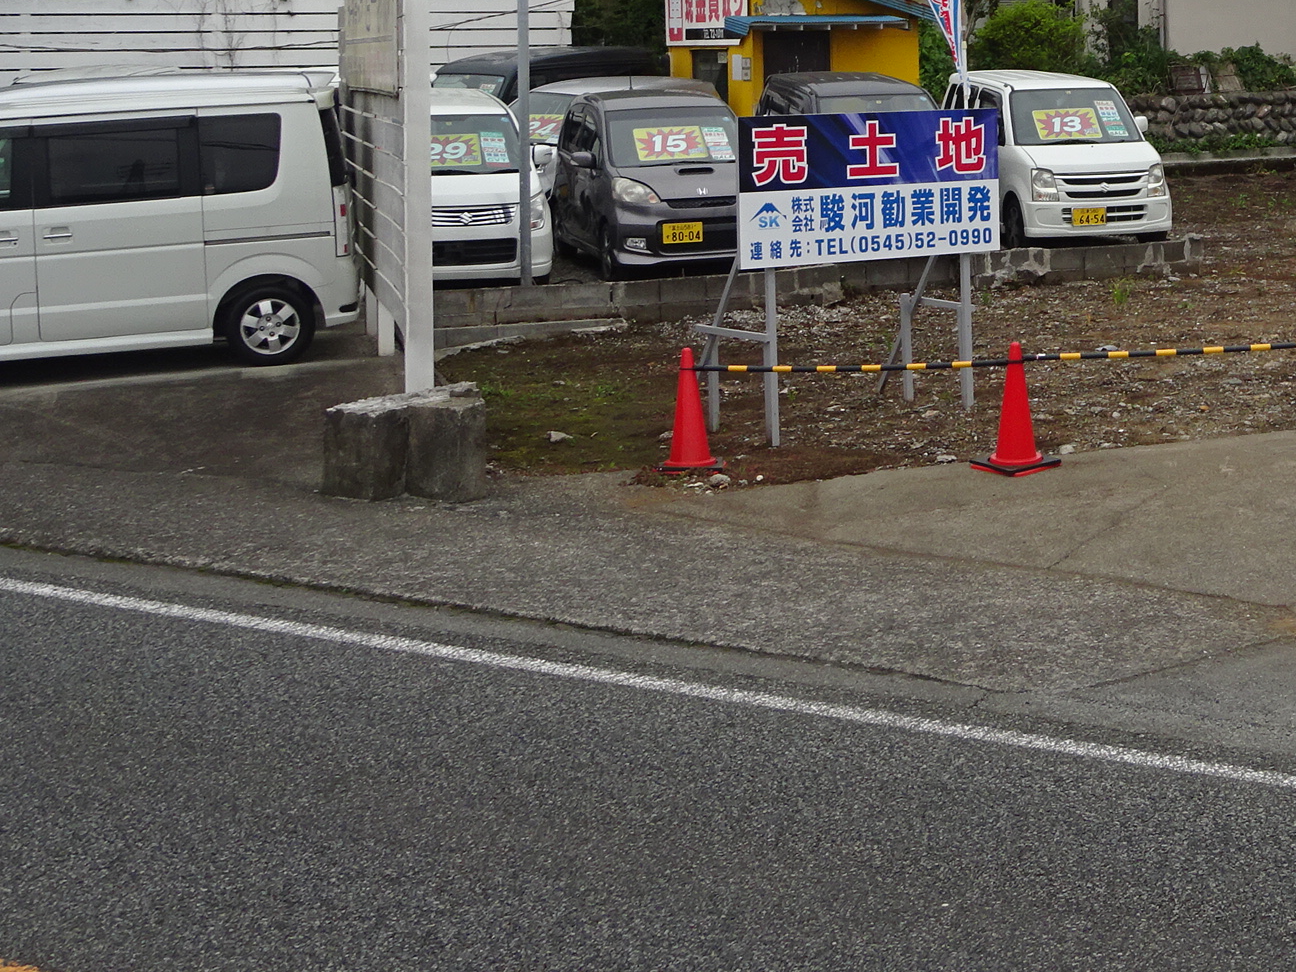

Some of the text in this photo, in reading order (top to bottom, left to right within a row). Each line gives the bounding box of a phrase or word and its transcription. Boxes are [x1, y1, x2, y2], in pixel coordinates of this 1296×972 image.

[1051, 115, 1082, 133] 13
[430, 141, 468, 161] 29
[652, 134, 688, 153] 15
[751, 116, 987, 187] 売土地
[790, 195, 816, 215] 株式
[818, 185, 992, 234] 駿河勧業開発
[758, 214, 781, 229] SK
[790, 213, 816, 234] 会社
[1079, 214, 1105, 225] 64-54
[671, 230, 701, 242] 80-04
